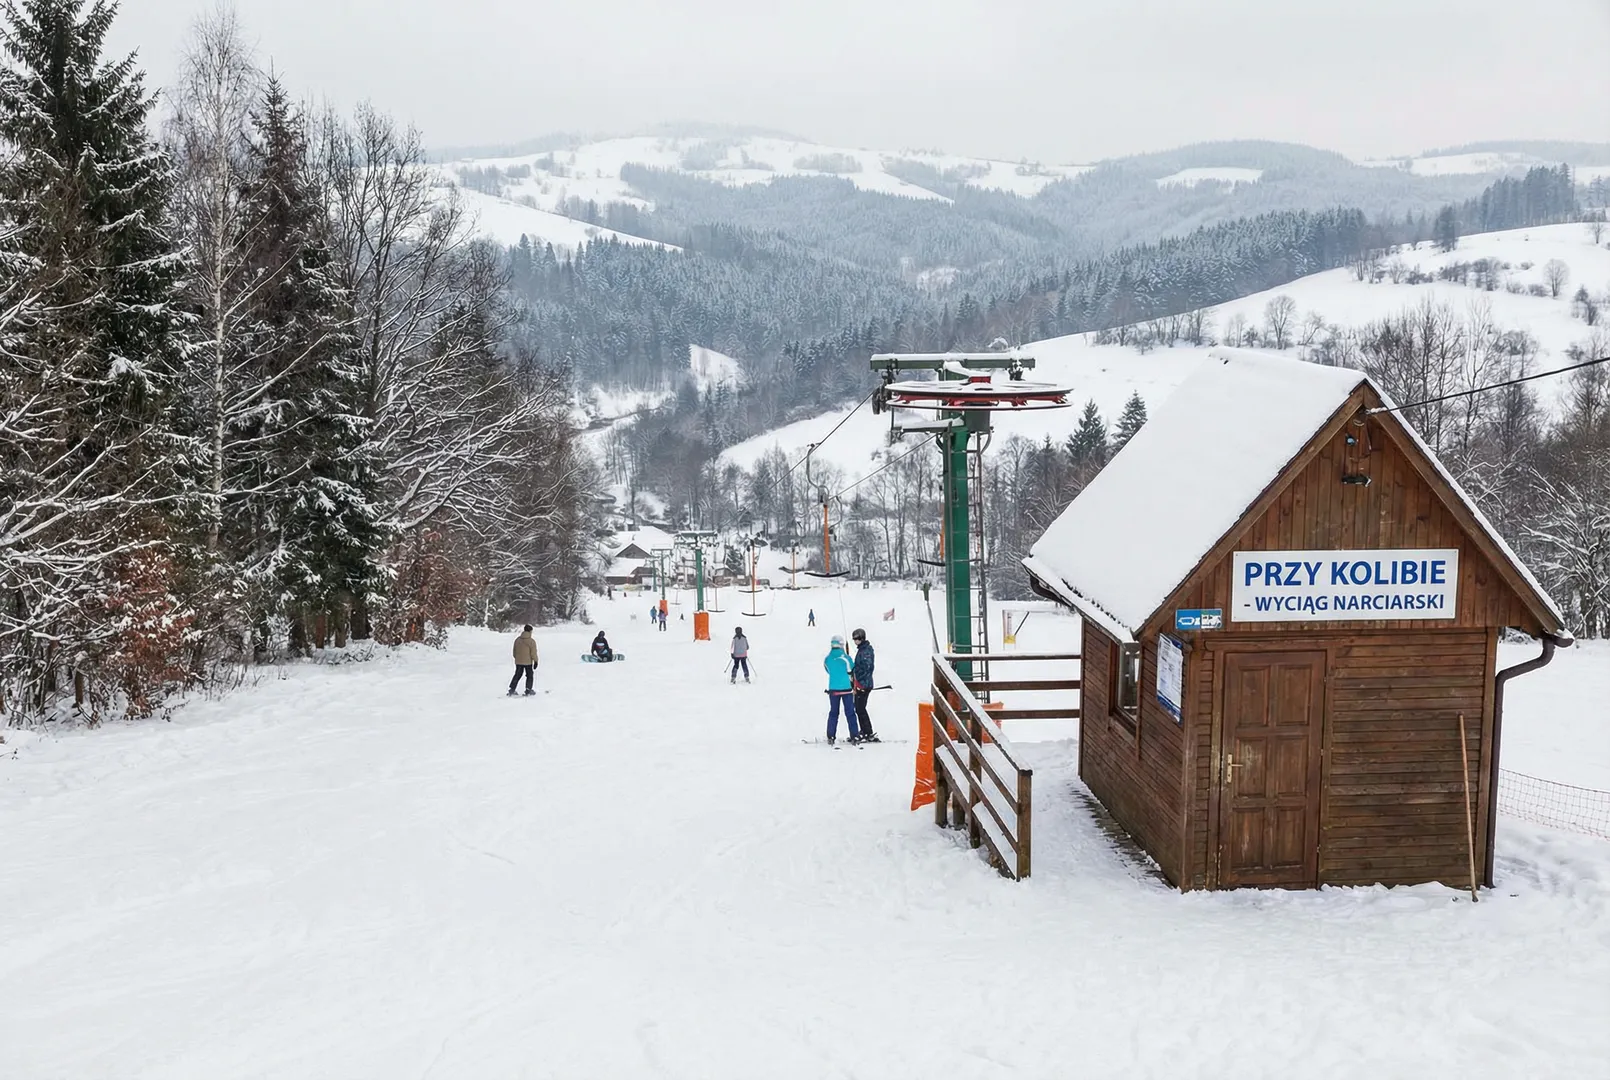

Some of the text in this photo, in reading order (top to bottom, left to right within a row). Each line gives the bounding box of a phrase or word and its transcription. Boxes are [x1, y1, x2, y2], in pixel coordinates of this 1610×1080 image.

[1244, 560, 1447, 587] PRZY KOLIBIE
[1255, 595, 1329, 615] WYCIĄG
[1334, 594, 1445, 611] NARCIARSKI
